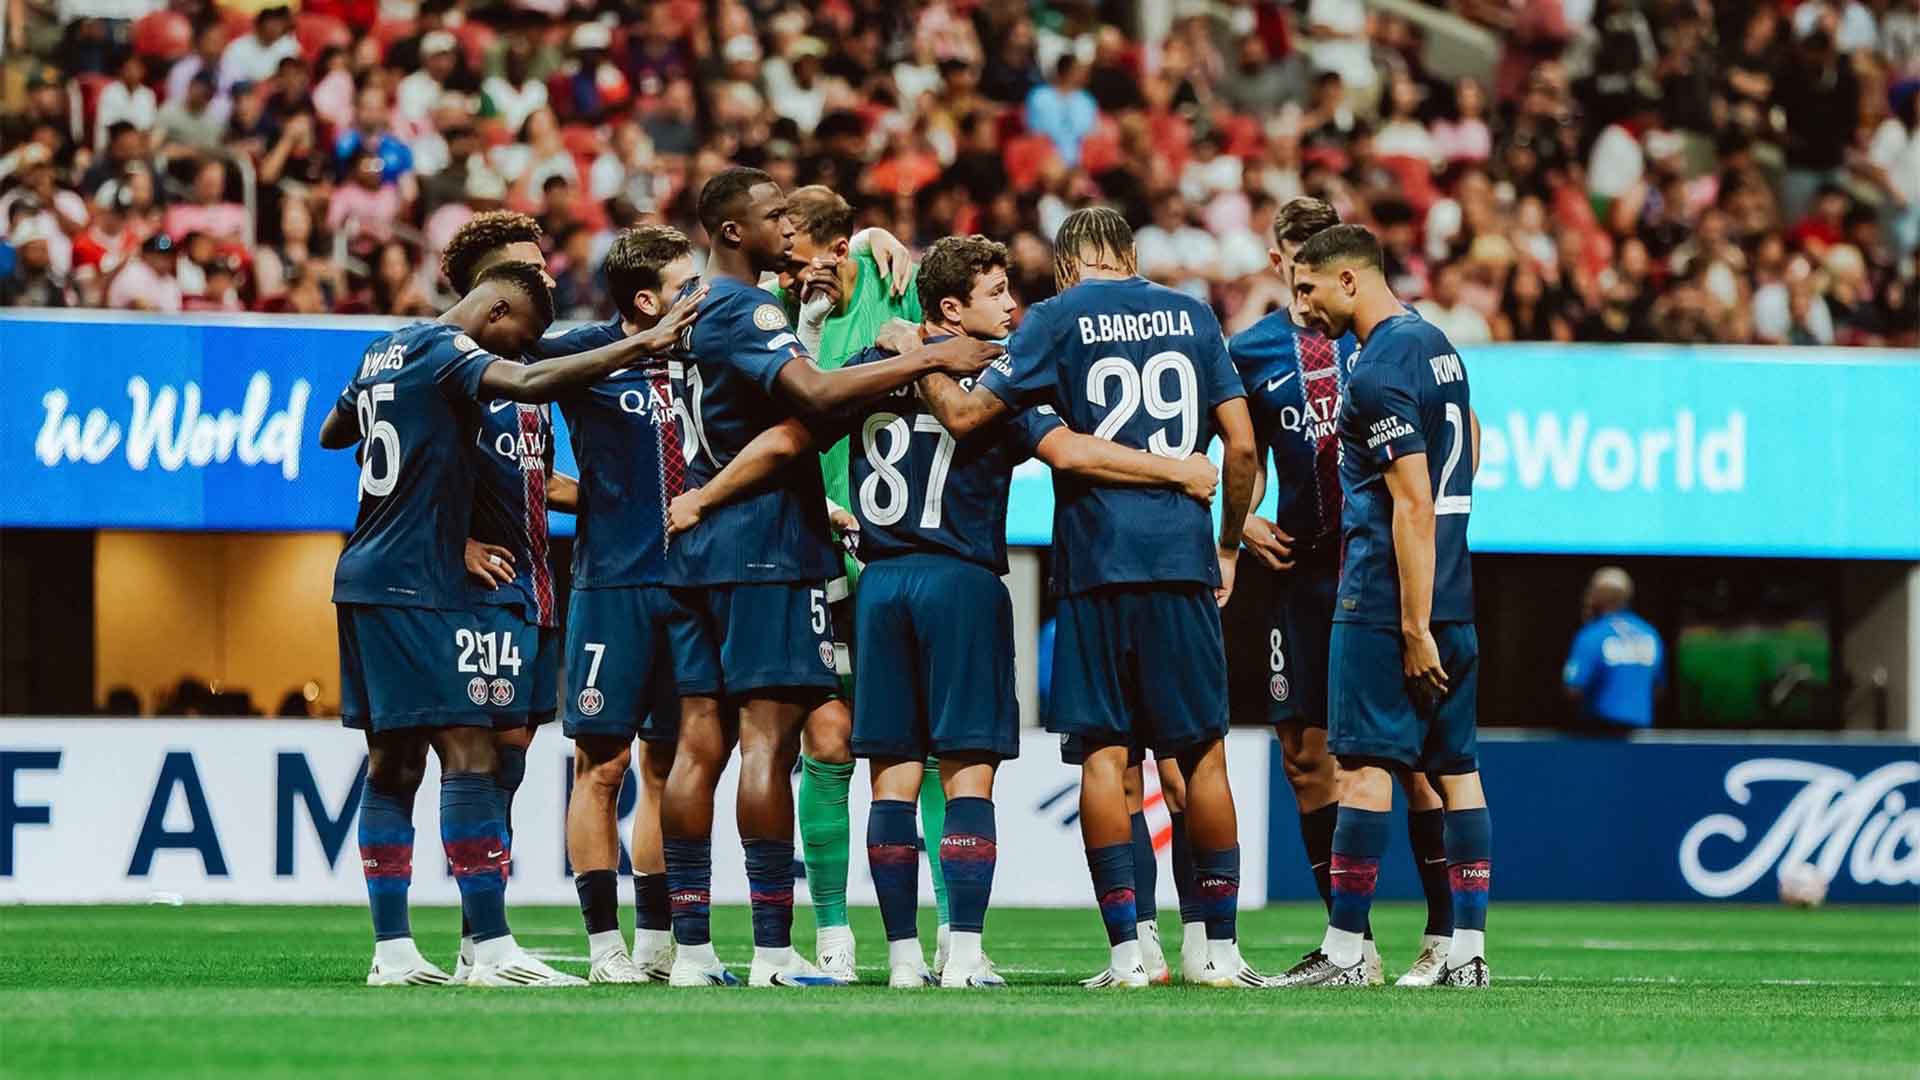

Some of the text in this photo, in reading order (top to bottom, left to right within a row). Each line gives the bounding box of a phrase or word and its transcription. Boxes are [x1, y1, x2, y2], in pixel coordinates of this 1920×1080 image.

[1078, 310, 1194, 345] B.BARCOLA
[126, 369, 312, 481] World
[1086, 350, 1199, 461] 29
[1369, 415, 1400, 435] VISIT
[1366, 422, 1416, 449] RWANDA
[858, 411, 957, 529] 87
[1434, 401, 1473, 516] 2
[810, 588, 826, 635] 5
[584, 643, 606, 687] 7
[1270, 628, 1285, 672] 8
